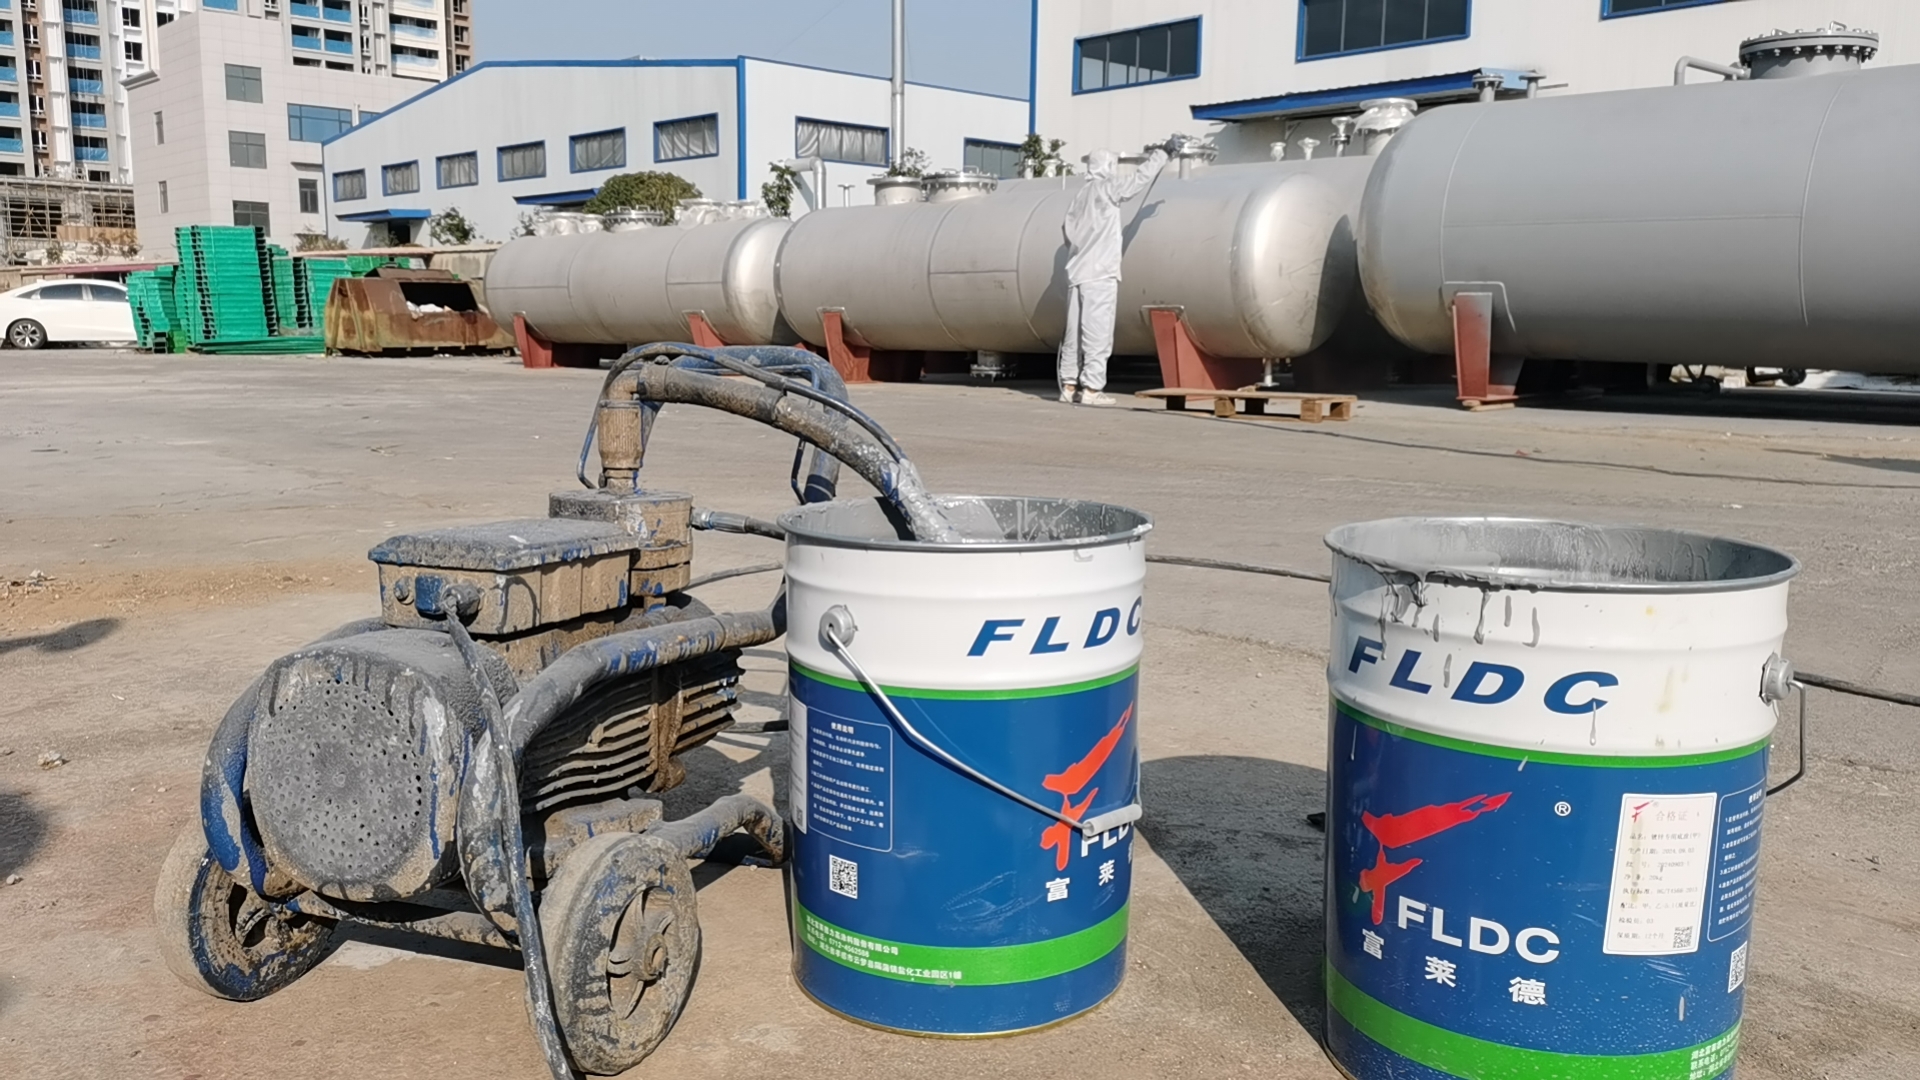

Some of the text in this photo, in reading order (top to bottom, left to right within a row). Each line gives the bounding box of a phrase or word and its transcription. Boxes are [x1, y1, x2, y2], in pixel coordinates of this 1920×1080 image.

[967, 595, 1142, 657] FLDC
[1348, 635, 1619, 715] FLDC
[1398, 896, 1561, 964] FLDC
